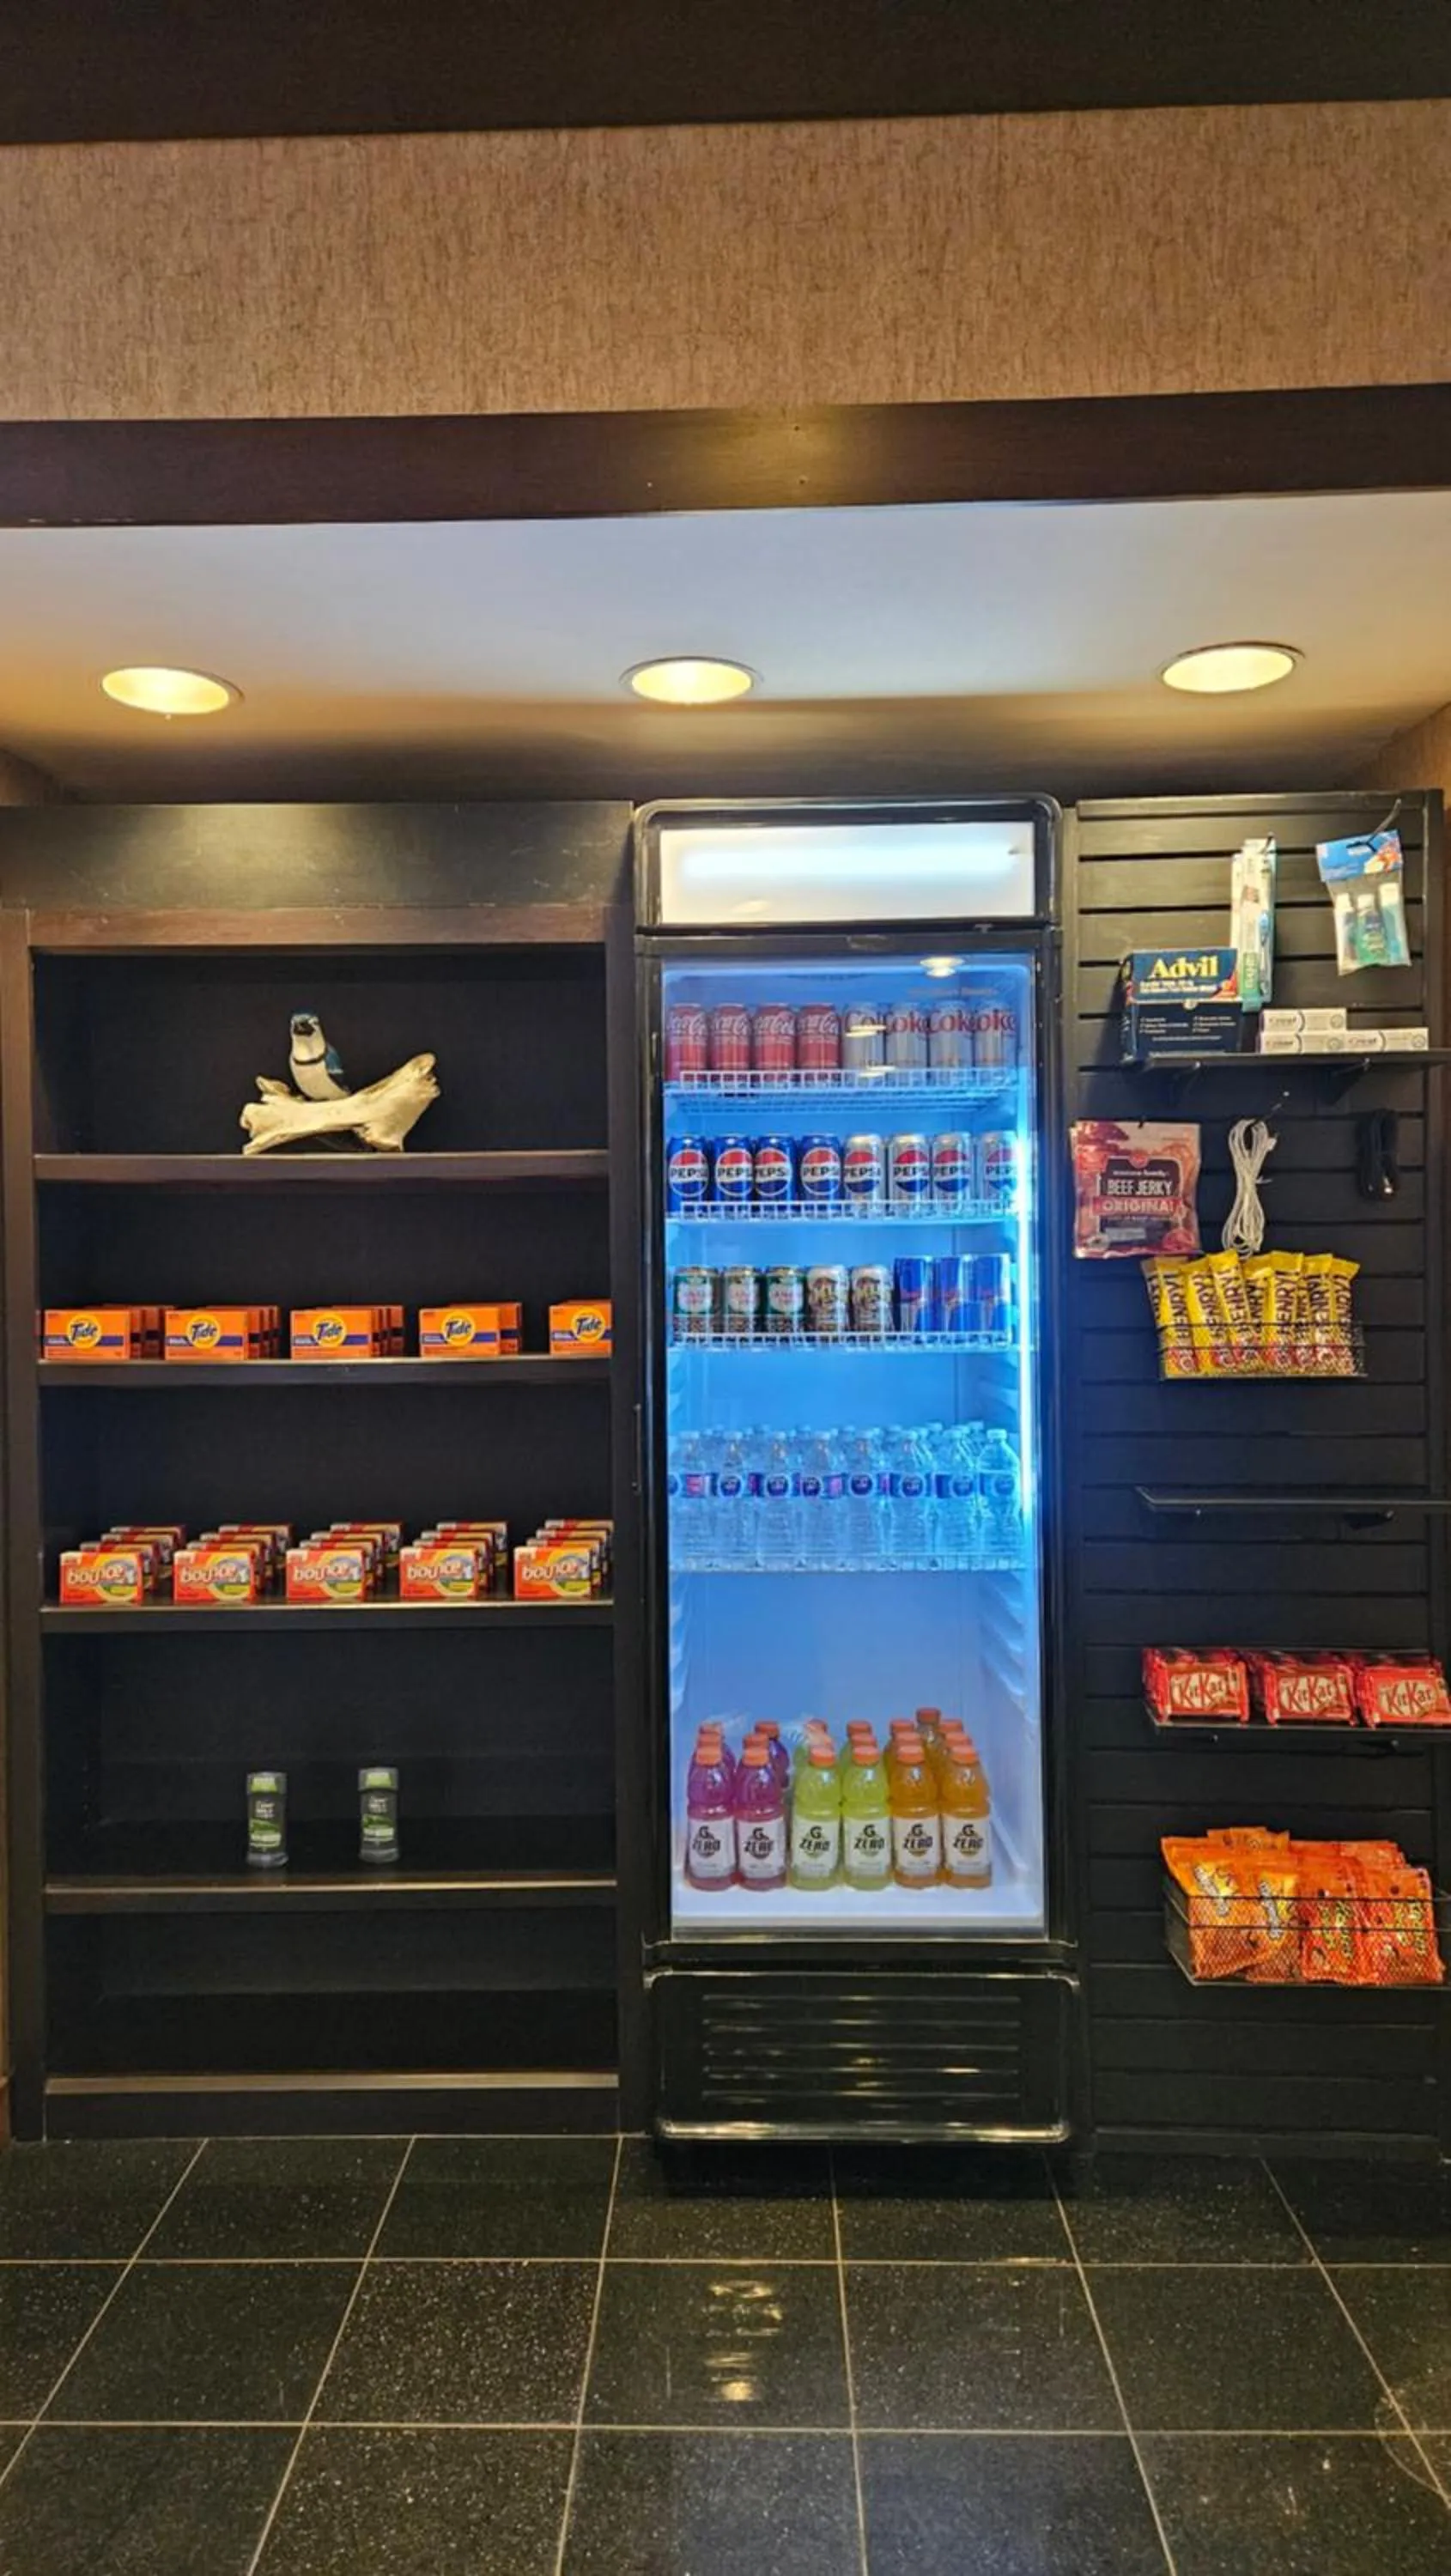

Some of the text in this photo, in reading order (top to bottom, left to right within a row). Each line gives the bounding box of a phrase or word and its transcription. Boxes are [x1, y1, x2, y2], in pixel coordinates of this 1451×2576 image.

[1148, 957, 1218, 978] Advil
[1108, 1179, 1174, 1196] BEEF JERKY
[698, 1826, 710, 1839] G
[751, 1826, 765, 1841] G
[809, 1826, 823, 1839] G
[863, 1824, 877, 1838] G
[910, 1823, 924, 1837] G
[961, 1824, 975, 1837] G
